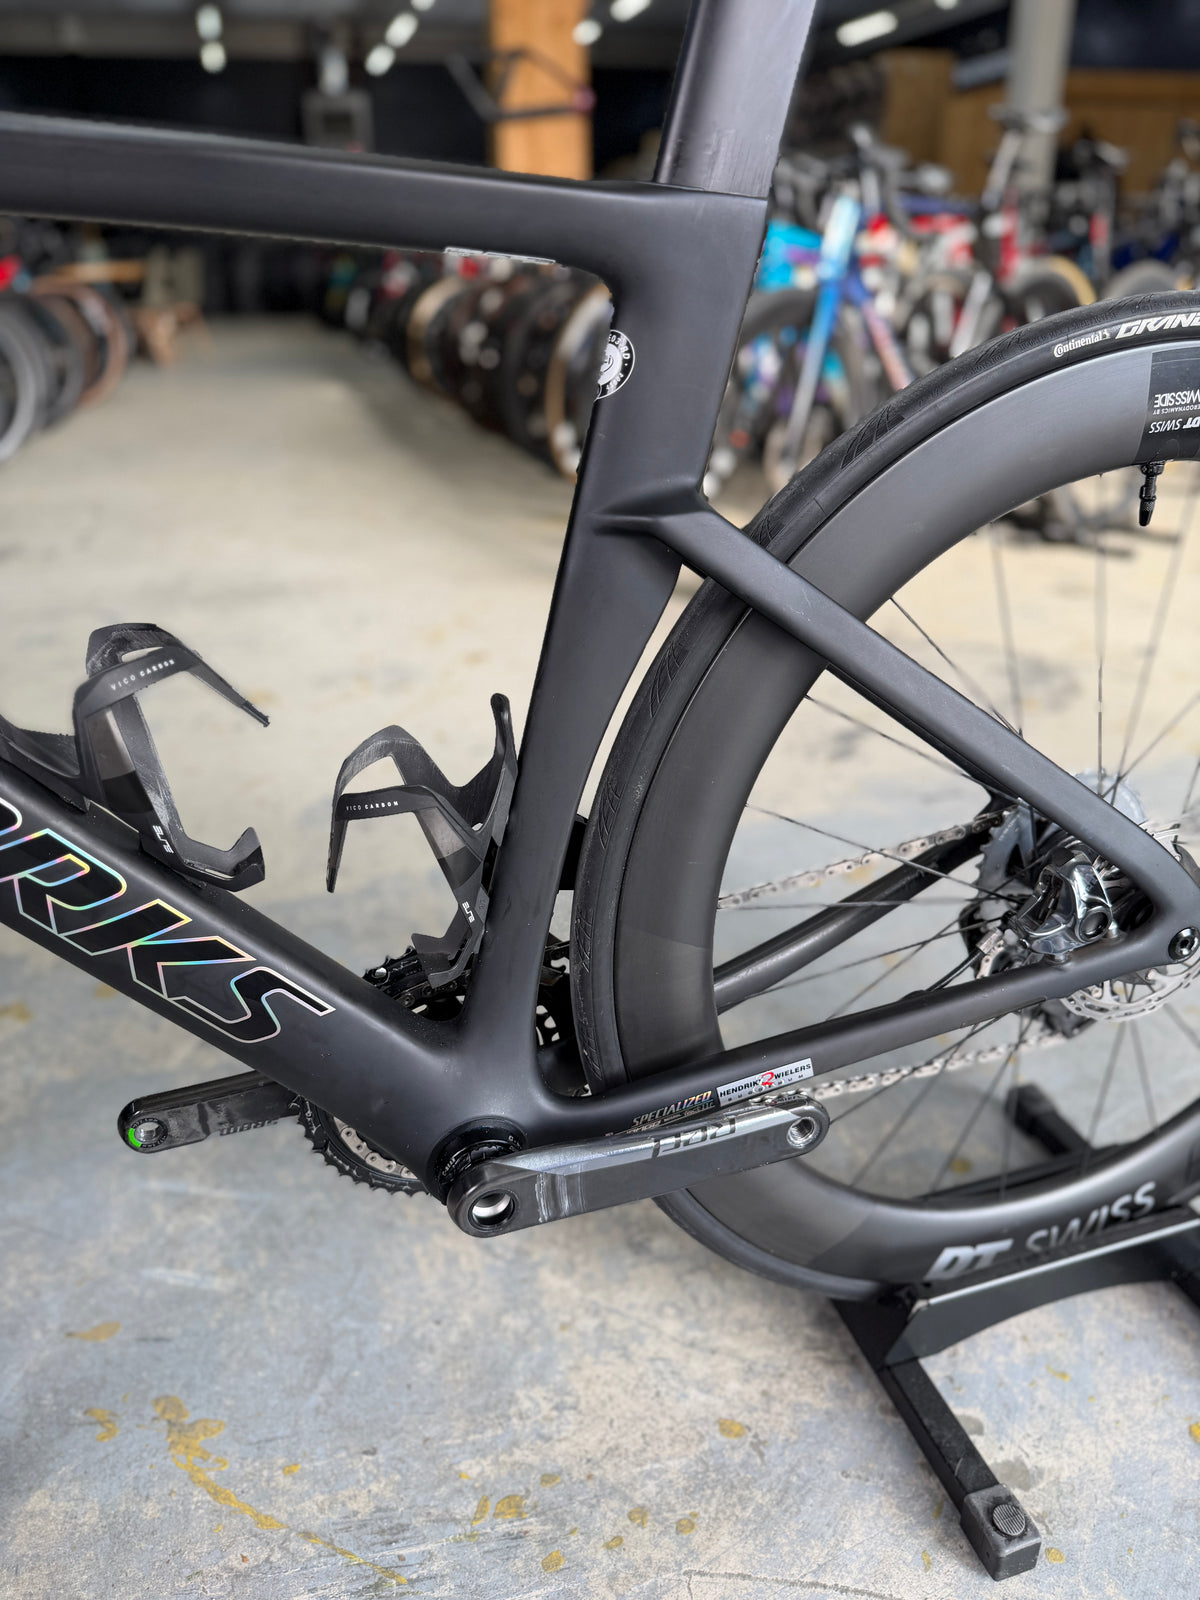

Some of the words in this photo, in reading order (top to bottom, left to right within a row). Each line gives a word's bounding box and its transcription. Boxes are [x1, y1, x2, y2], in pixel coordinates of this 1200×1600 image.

[1053, 329, 1103, 358] Continental
[1148, 418, 1183, 434] SWISS
[110, 674, 136, 691] VICO
[774, 1063, 812, 1081] WIELERS
[631, 1089, 713, 1127] SPECIALIZED
[923, 1238, 1014, 1281] DT
[1025, 1181, 1157, 1254] SWISS
